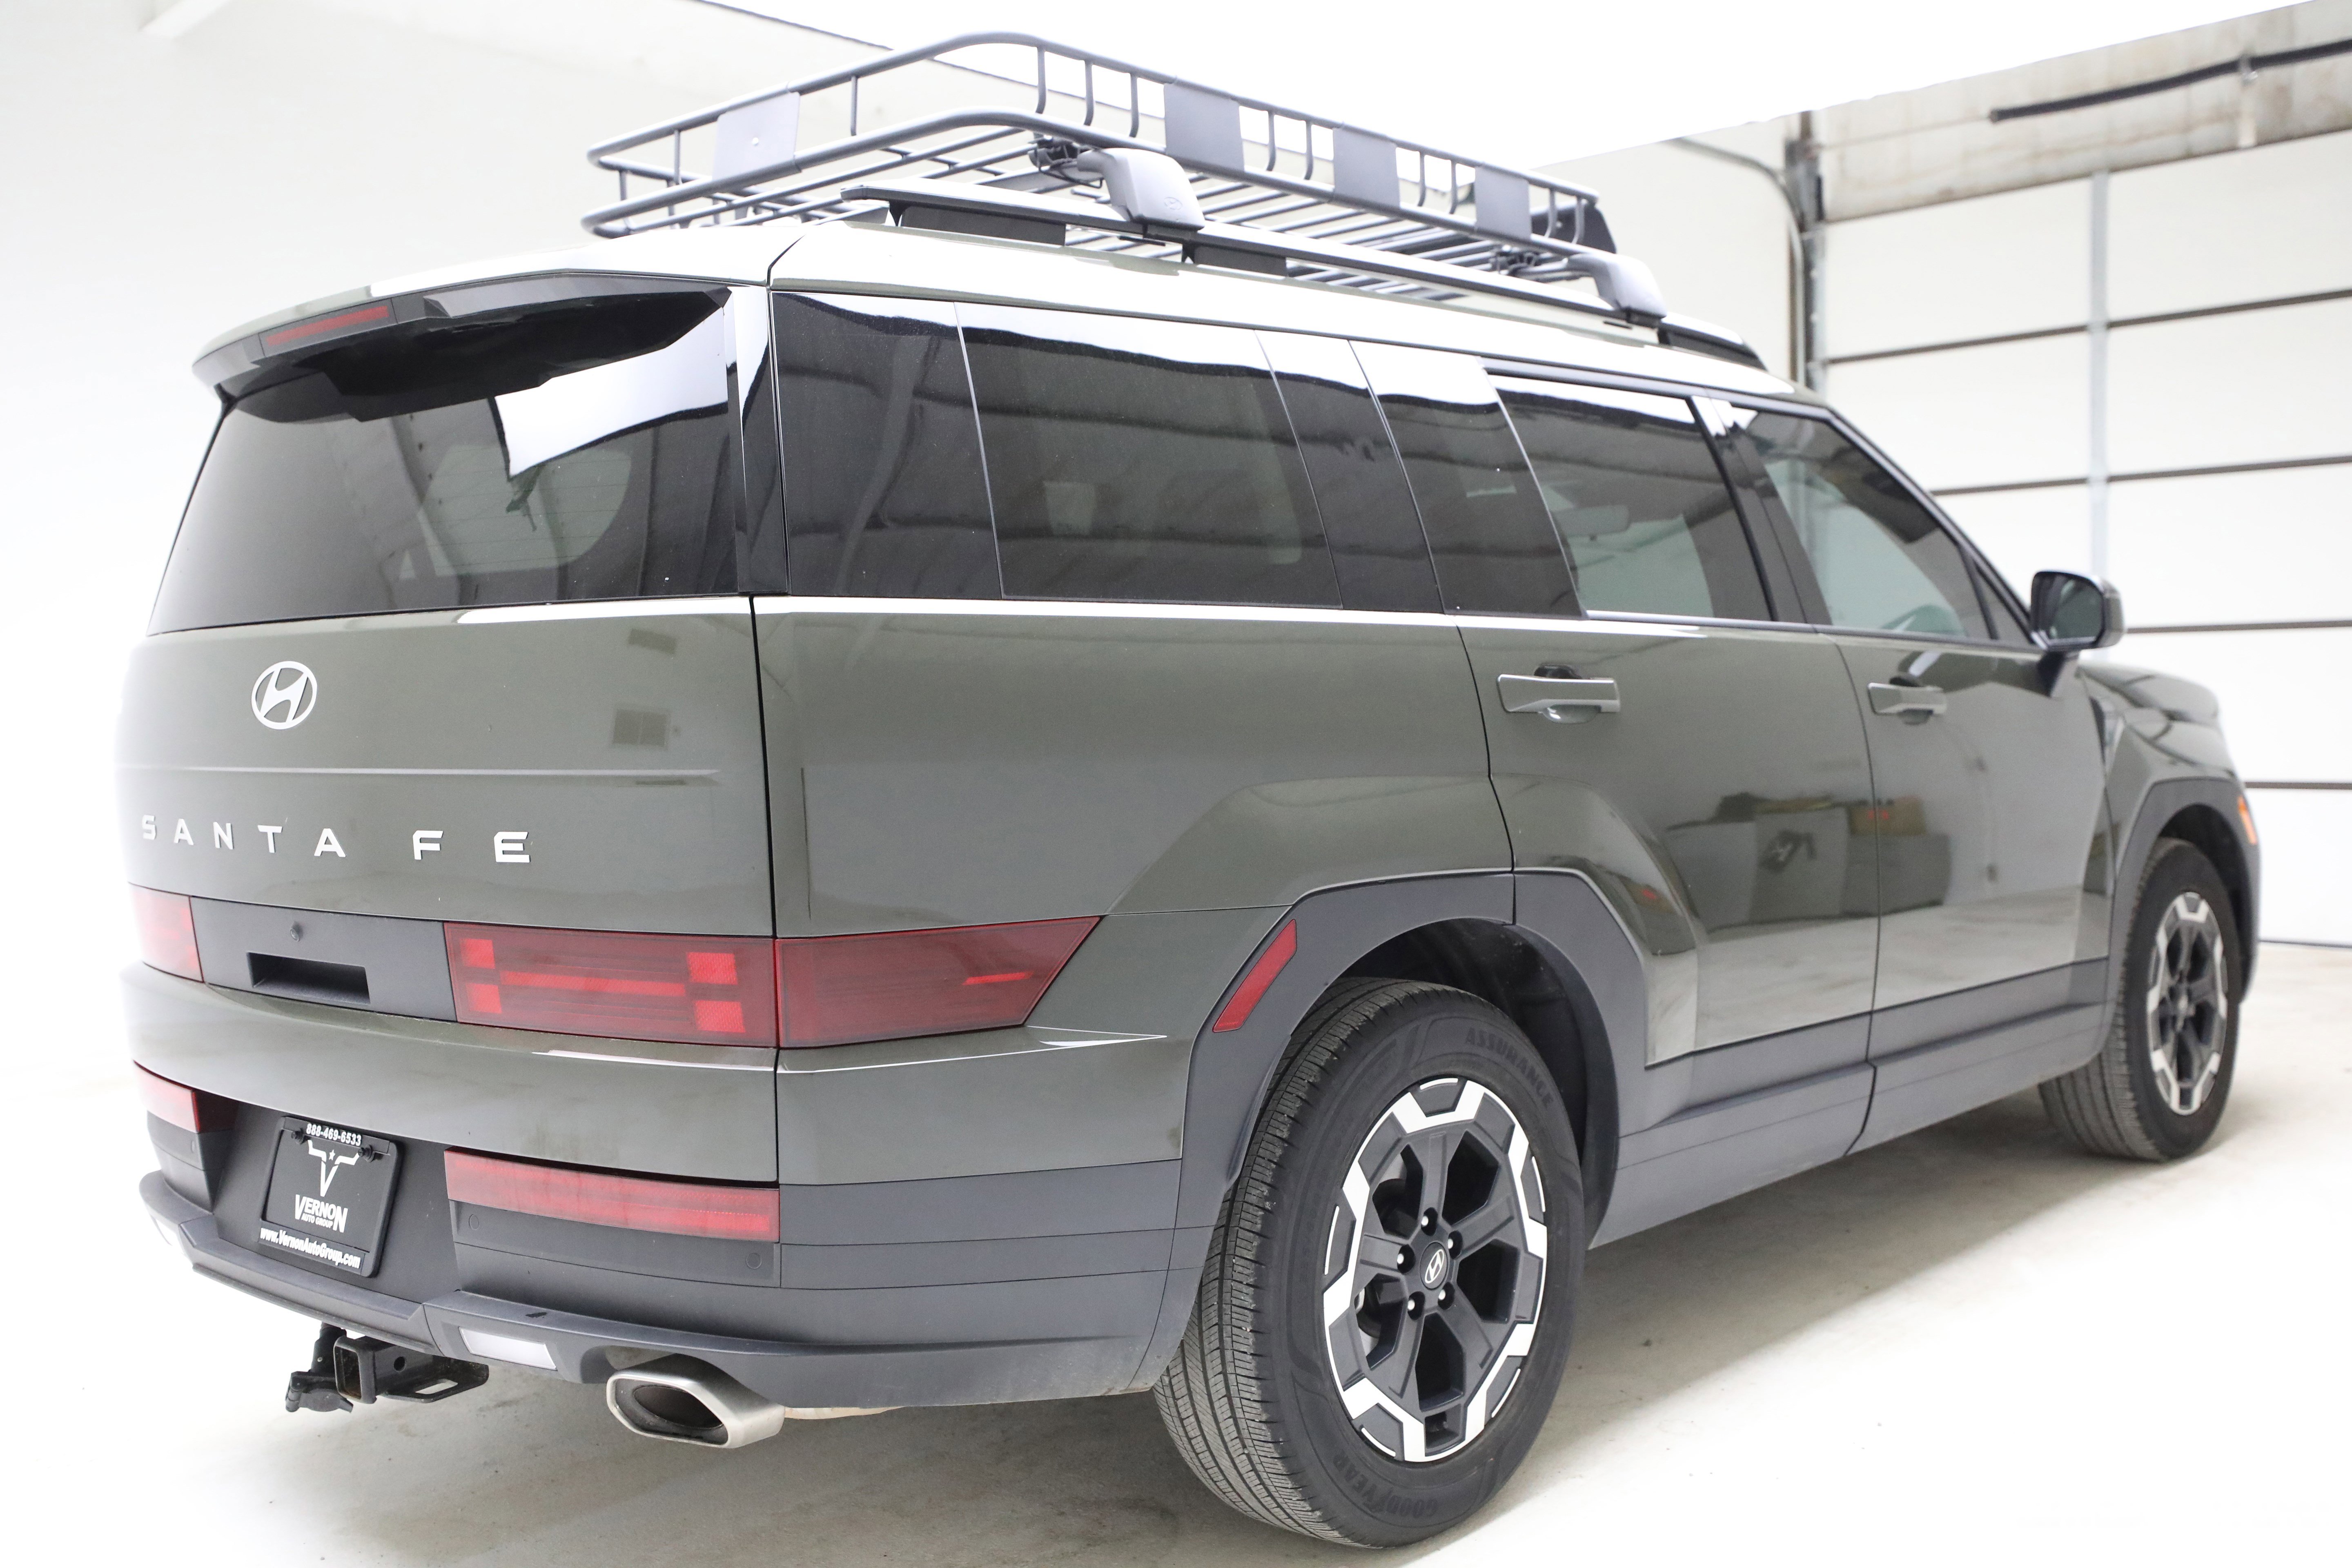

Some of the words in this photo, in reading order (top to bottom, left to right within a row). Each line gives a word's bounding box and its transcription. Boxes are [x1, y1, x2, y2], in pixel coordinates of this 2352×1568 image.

[142, 814, 346, 858] SANTA
[412, 830, 531, 863] FE
[306, 1123, 361, 1146] 888-469-6533
[295, 1194, 348, 1233] VERNON
[301, 1213, 315, 1223] AUTO
[315, 1217, 334, 1229] GROUP
[260, 1227, 361, 1269] www.VernonAutoGroup.com
